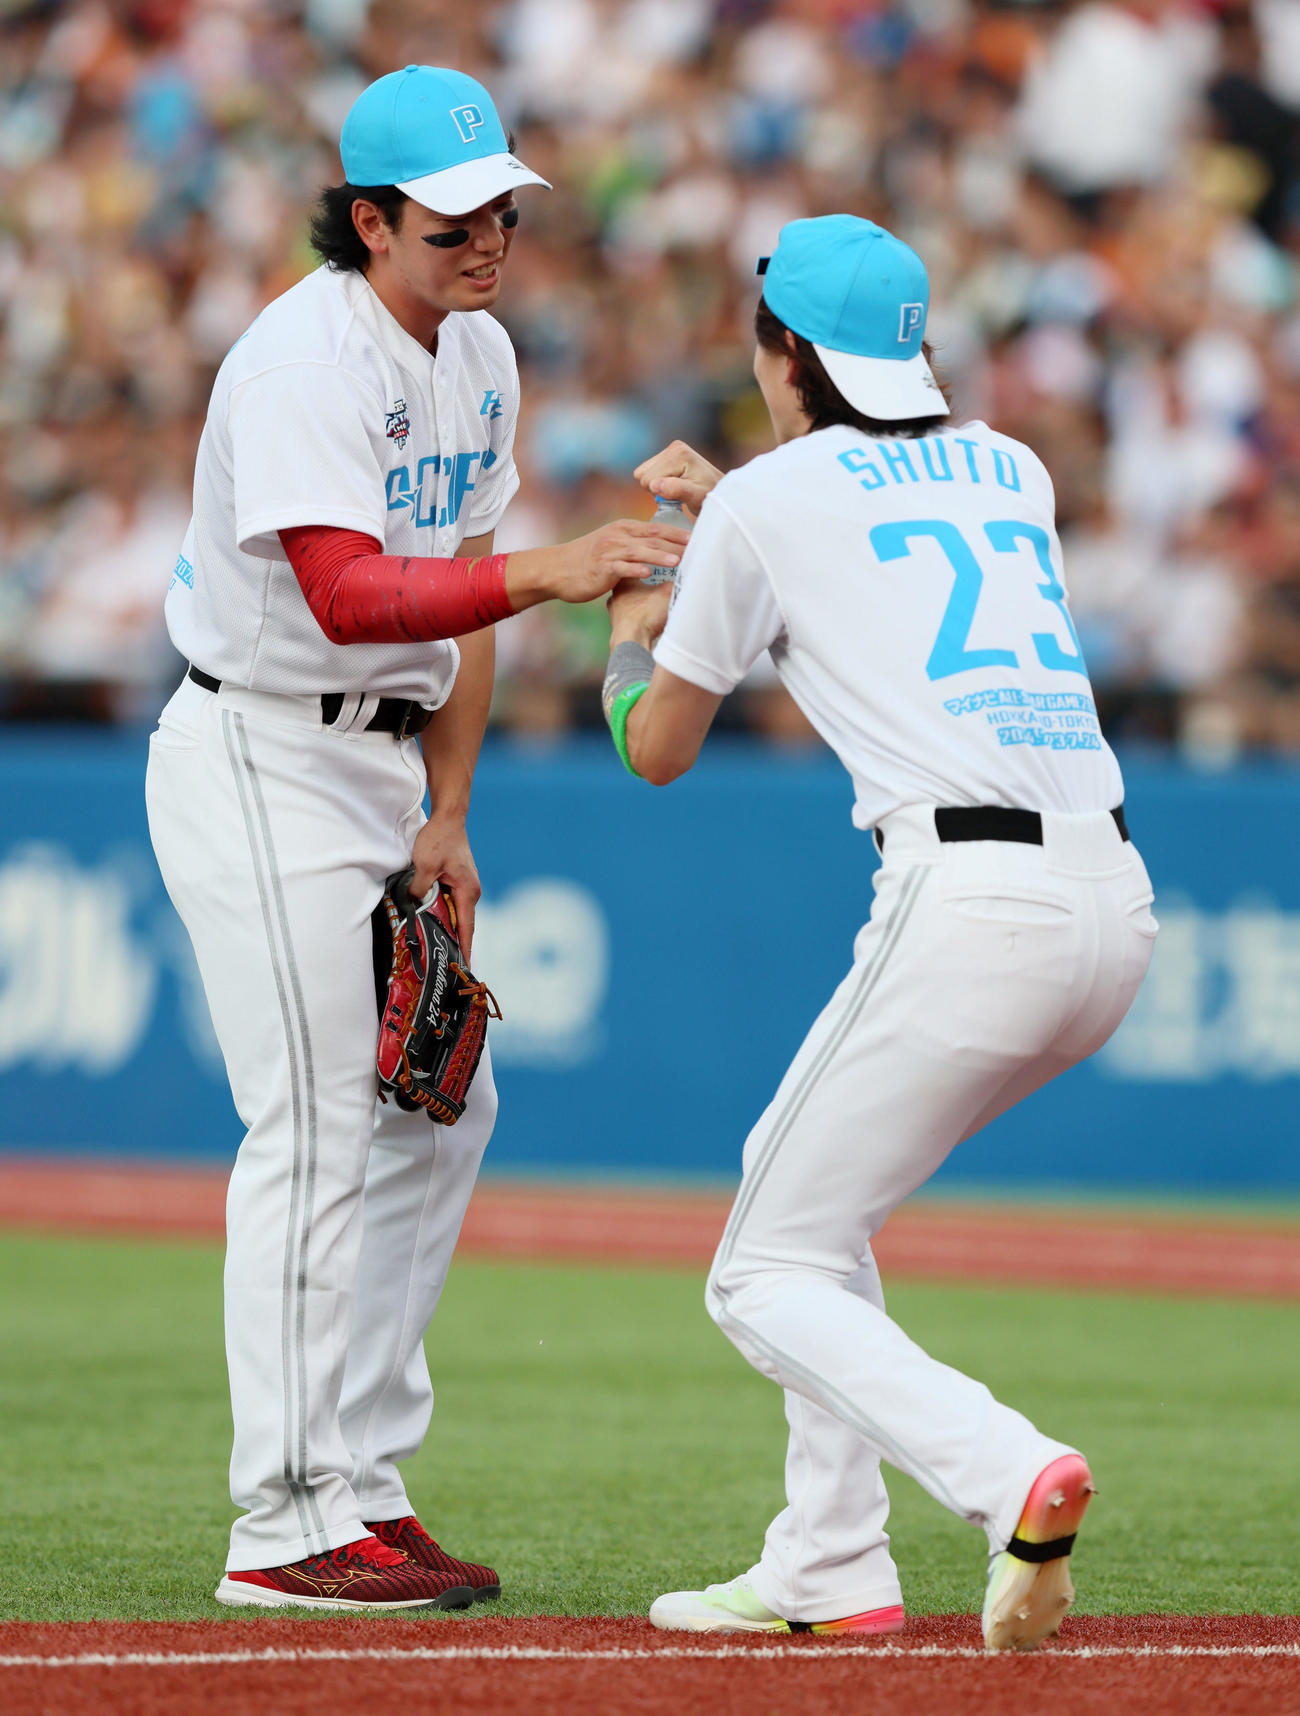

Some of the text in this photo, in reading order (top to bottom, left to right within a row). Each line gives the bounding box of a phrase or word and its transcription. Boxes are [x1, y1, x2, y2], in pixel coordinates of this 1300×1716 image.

[449, 104, 484, 144] P
[897, 302, 924, 343] P
[837, 437, 1021, 493] SHUTO
[869, 519, 1090, 681] 23
